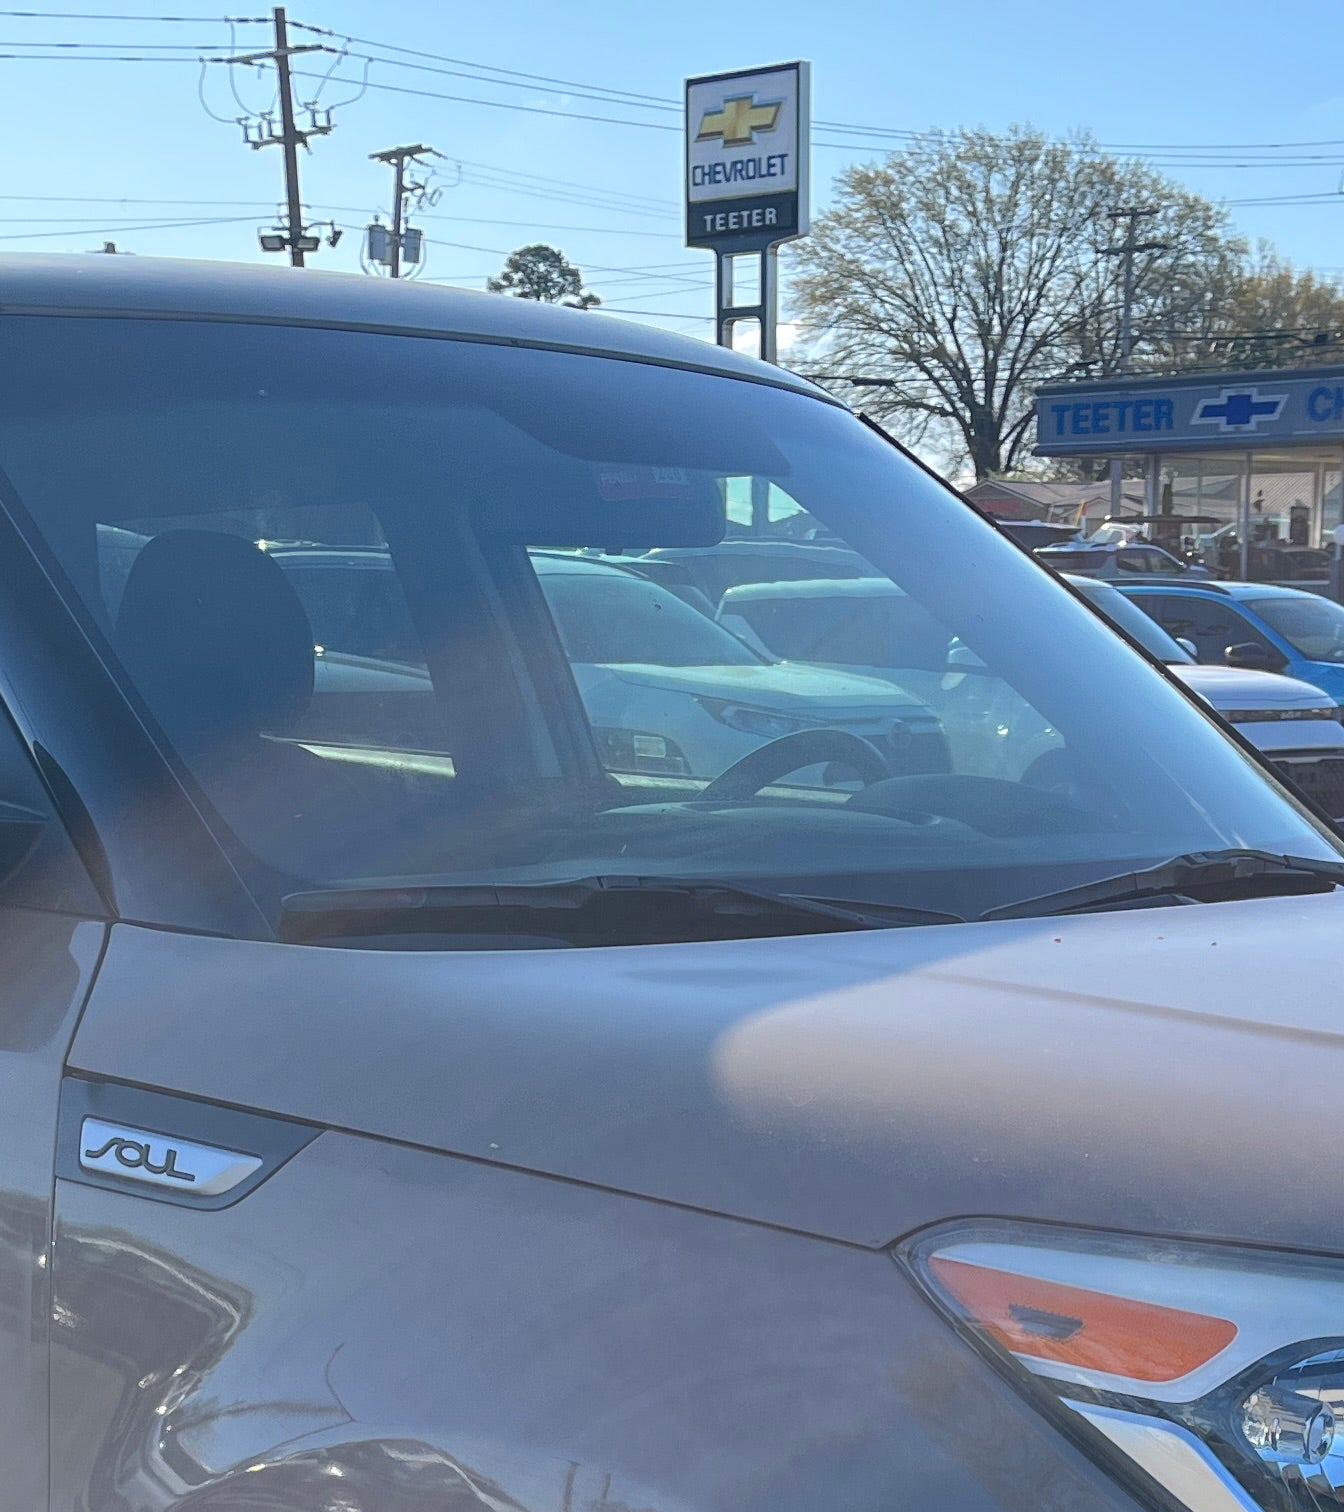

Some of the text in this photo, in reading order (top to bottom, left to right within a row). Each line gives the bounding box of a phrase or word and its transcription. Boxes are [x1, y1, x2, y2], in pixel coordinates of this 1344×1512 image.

[692, 154, 788, 186] CHEVROLET
[704, 207, 777, 232] TEETER
[1051, 398, 1175, 436] TEETER
[85, 1137, 196, 1182] SOUL
